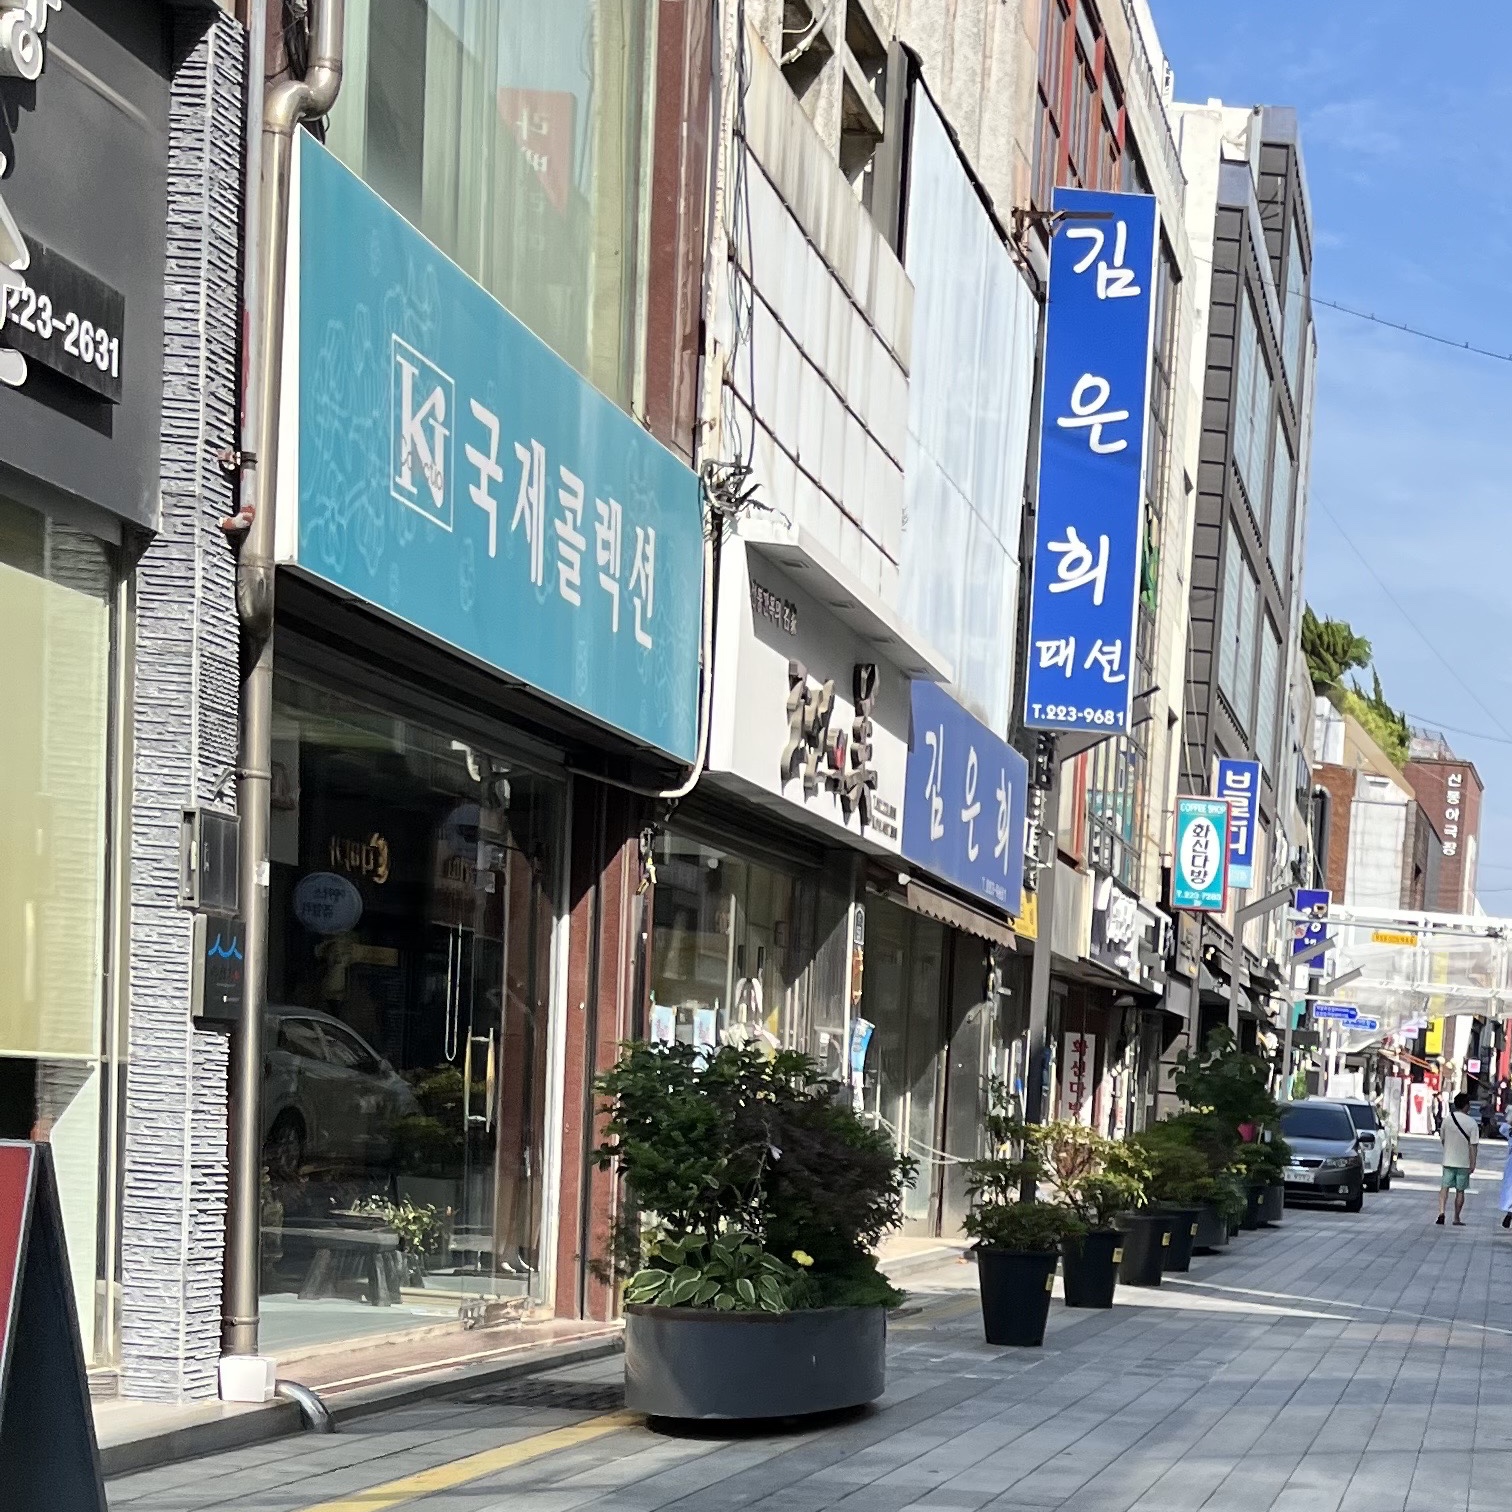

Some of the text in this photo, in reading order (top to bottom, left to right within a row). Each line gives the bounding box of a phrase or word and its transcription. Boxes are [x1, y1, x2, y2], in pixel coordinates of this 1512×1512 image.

[1048, 221, 1142, 606] 김은희
[465, 397, 656, 650] 국제콜렉션
[1032, 703, 1124, 726] T.223-9681
[1035, 636, 1126, 683] 패션
[925, 723, 1013, 877] 김은희
